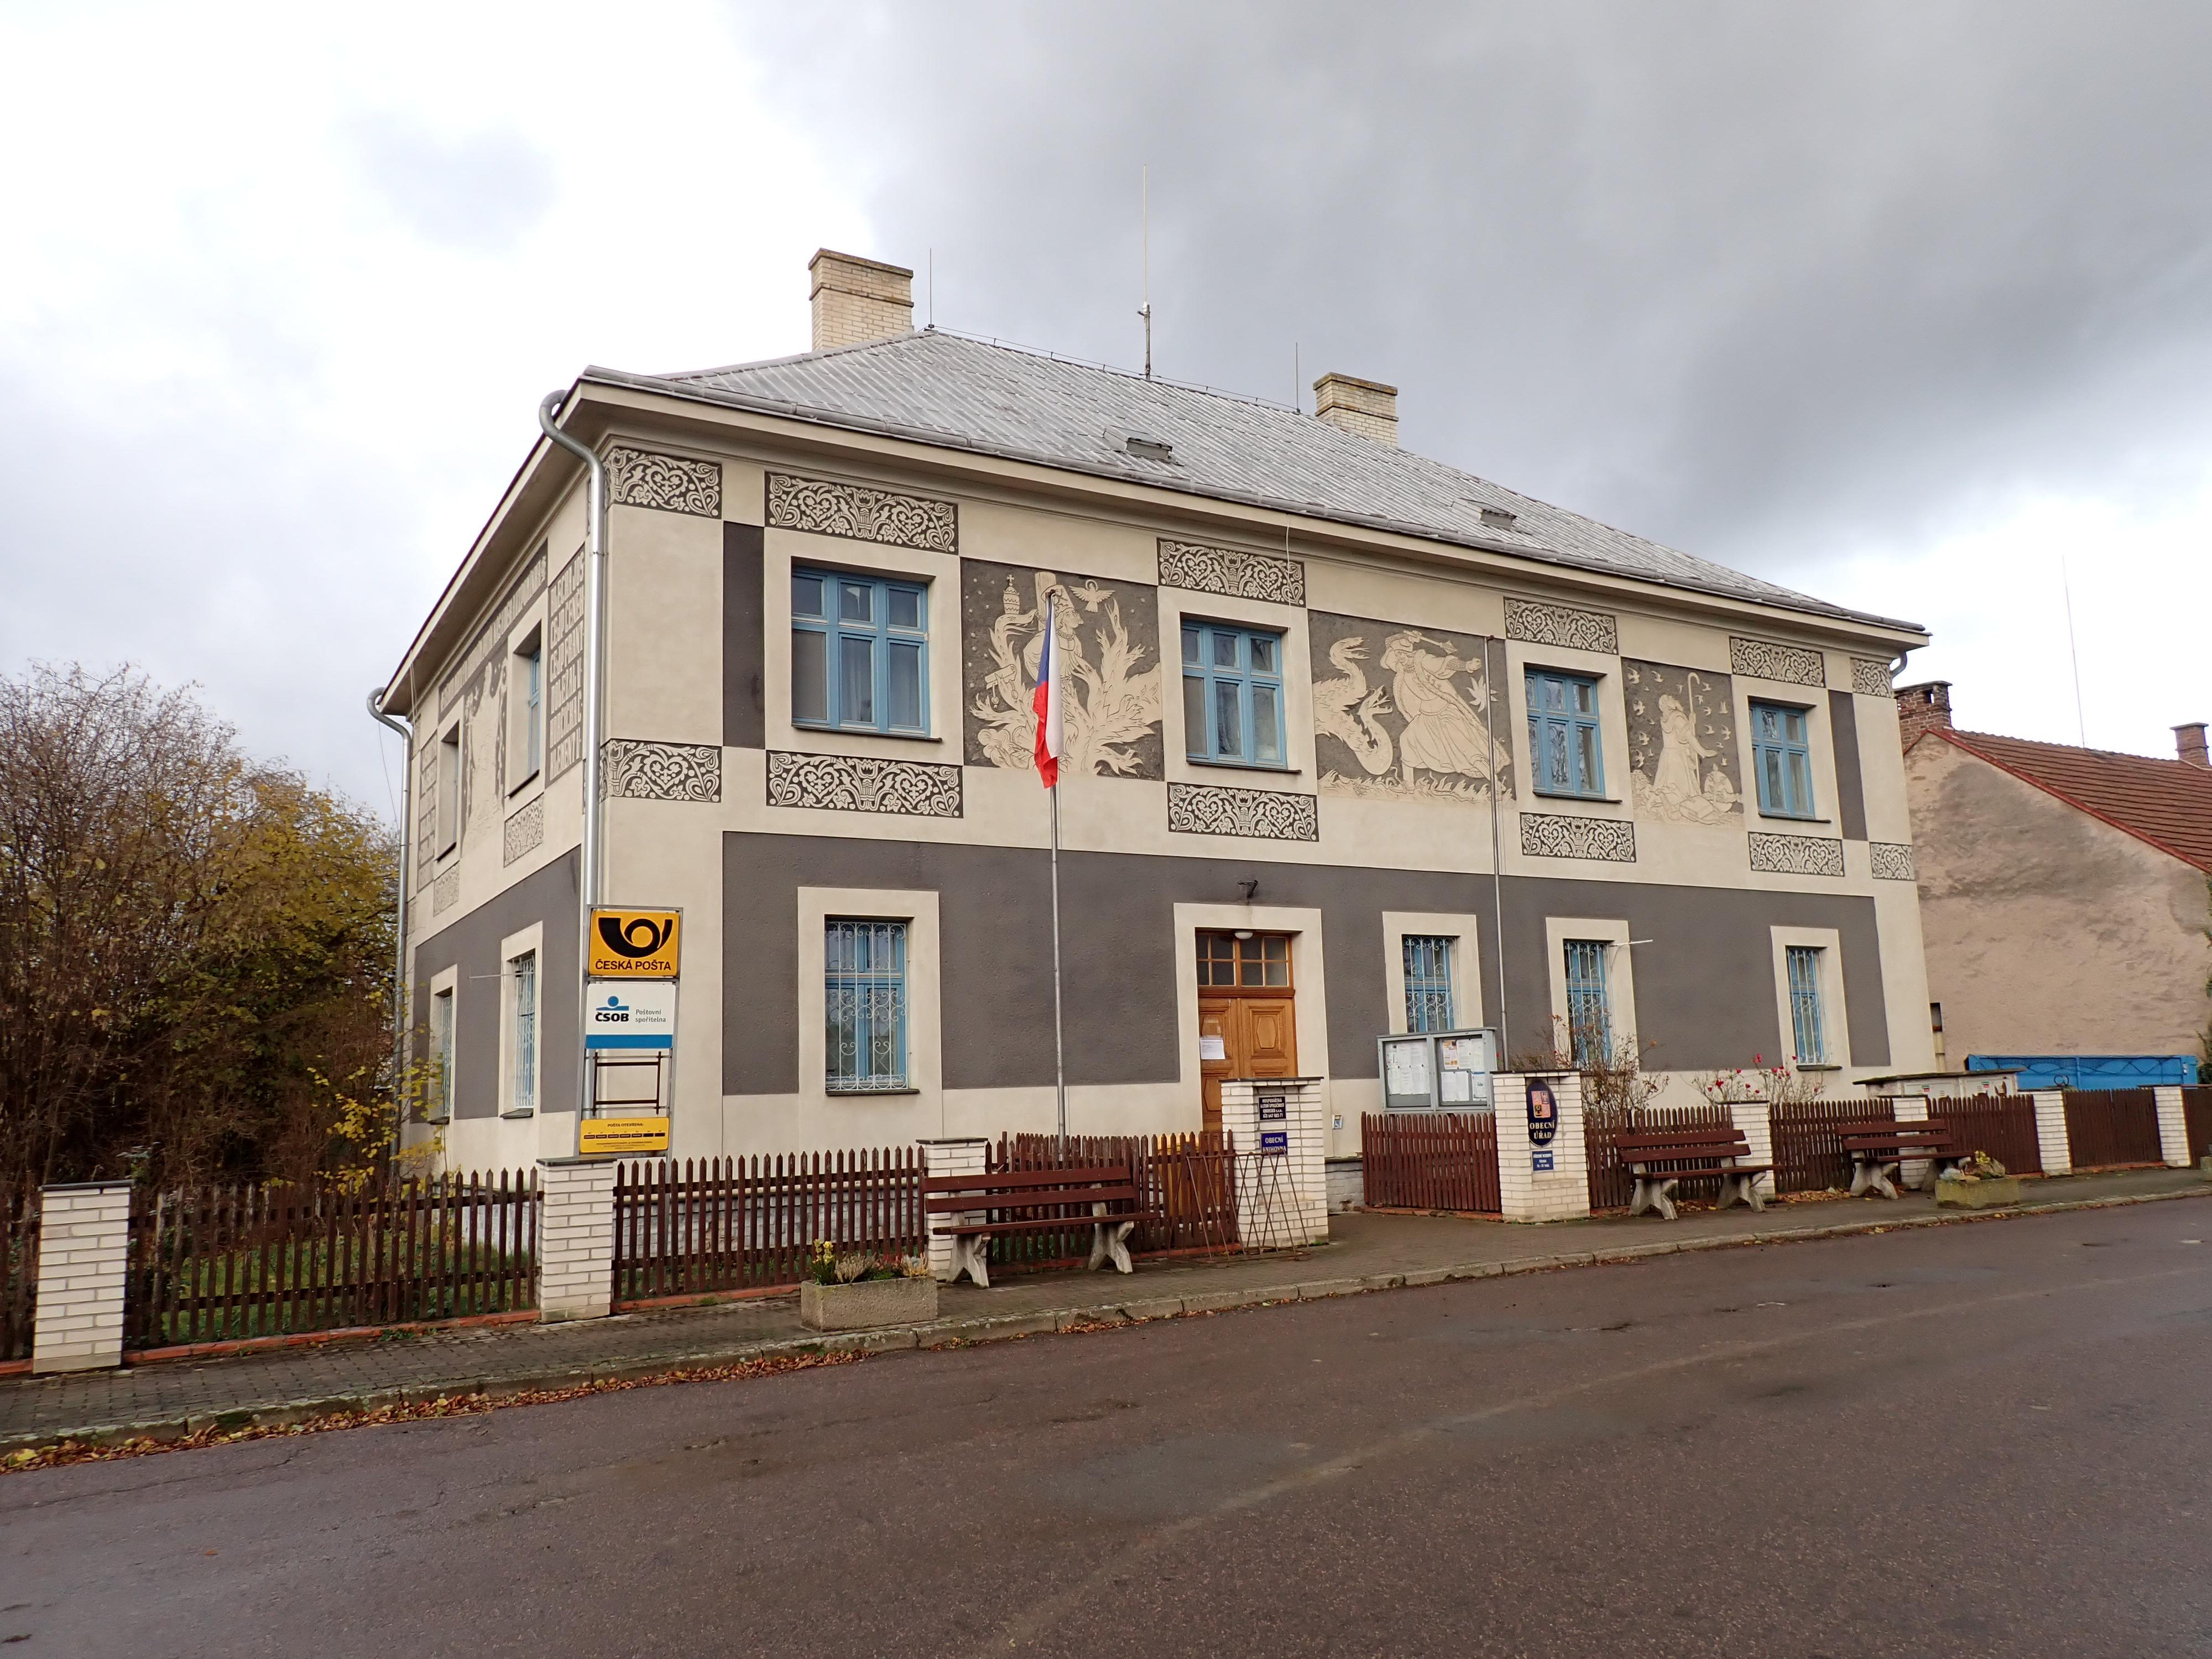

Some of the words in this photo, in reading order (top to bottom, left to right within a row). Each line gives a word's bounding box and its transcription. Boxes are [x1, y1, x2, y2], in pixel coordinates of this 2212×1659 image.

[596, 959, 633, 969] ČESKÁ
[635, 959, 671, 971] POŠTA
[595, 1011, 629, 1022] ČSOB
[1530, 1120, 1555, 1129] OBECNÍ
[1533, 1130, 1552, 1139] ÚŘAD
[1265, 1135, 1283, 1144] OBECNÍ
